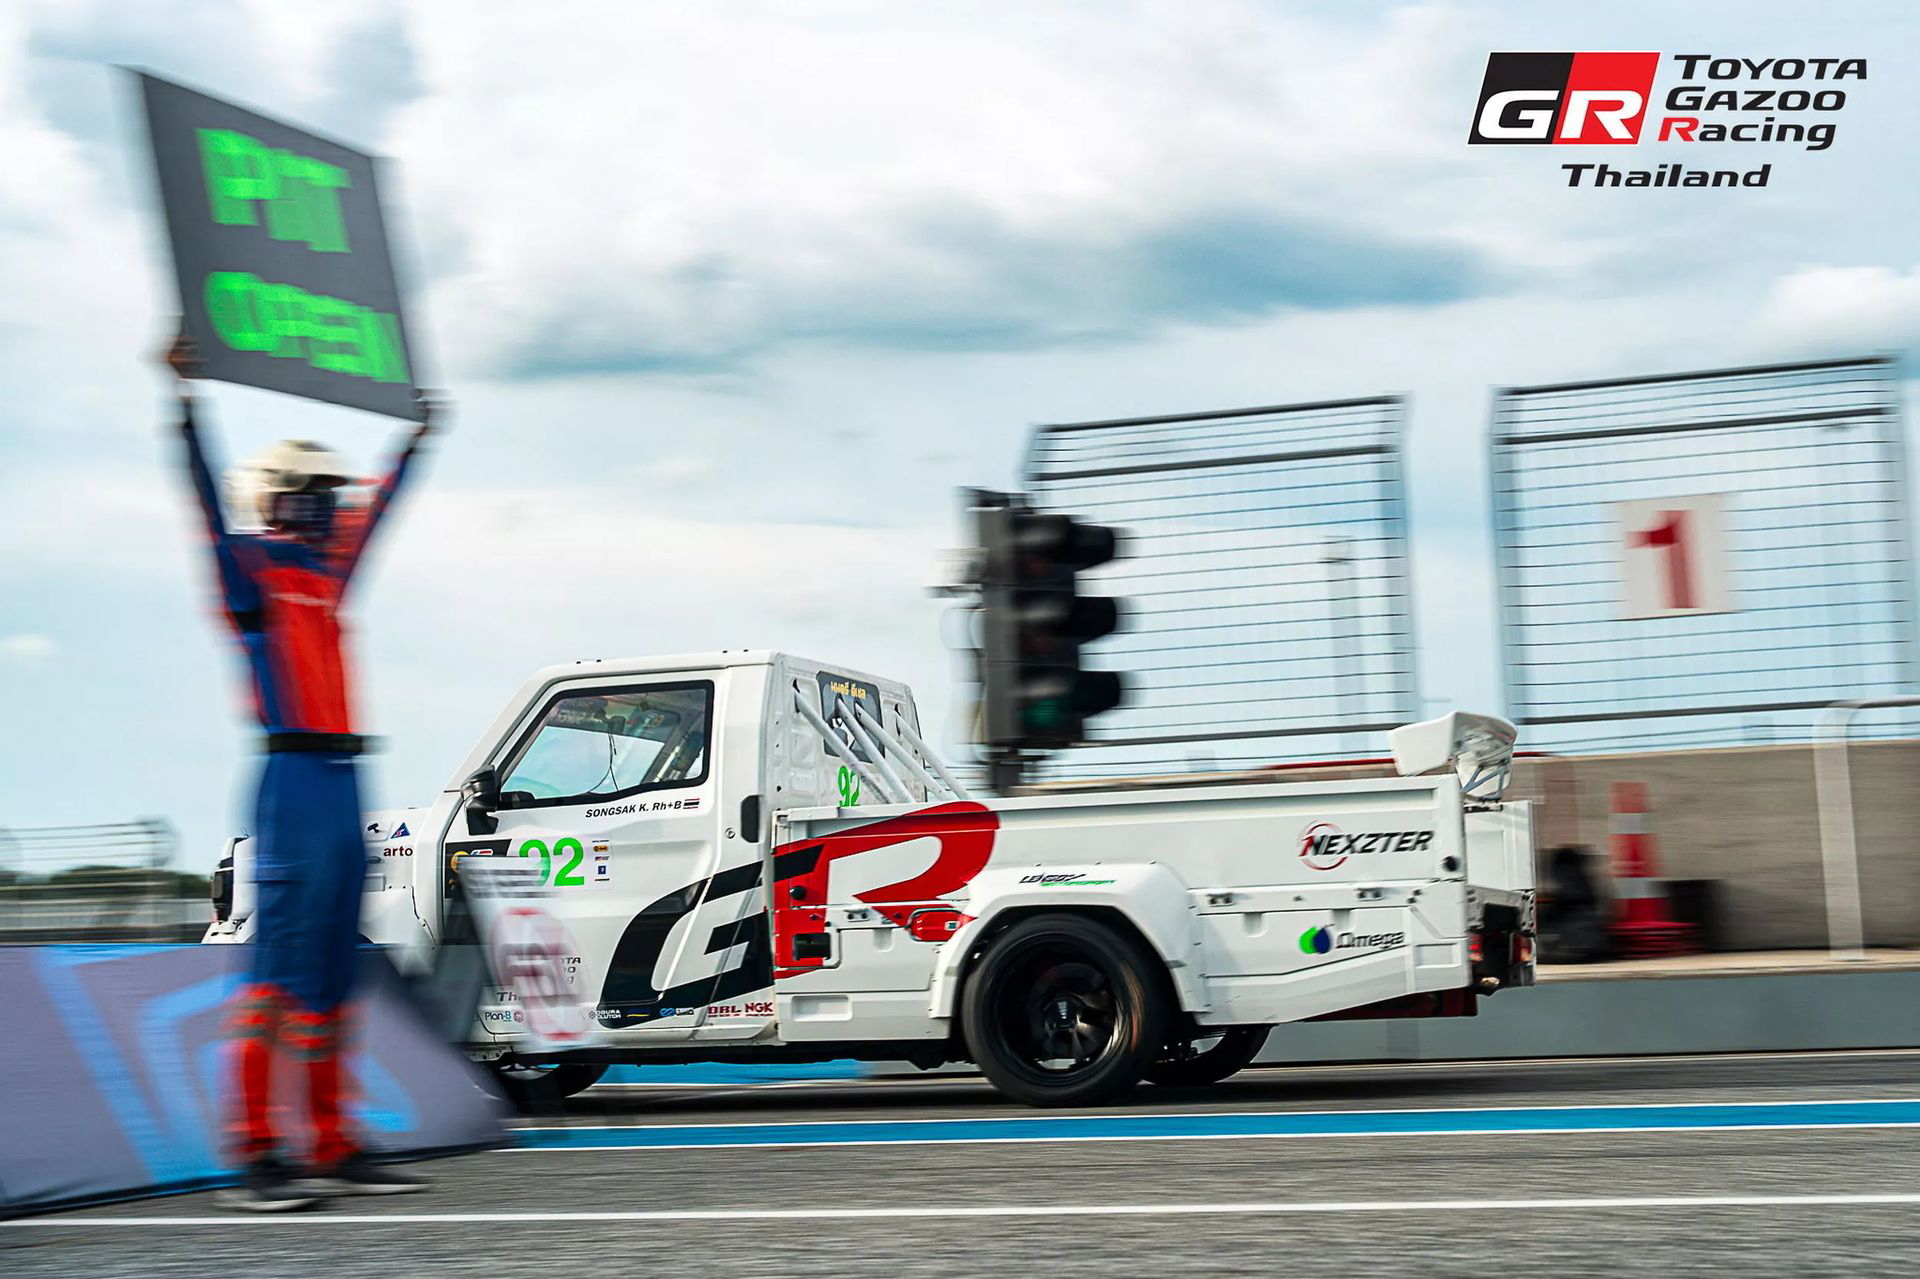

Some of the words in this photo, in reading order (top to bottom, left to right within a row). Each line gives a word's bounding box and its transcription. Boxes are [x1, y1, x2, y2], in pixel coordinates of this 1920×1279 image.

[194, 127, 353, 253] PIT
[203, 271, 411, 384] OPEN
[1627, 509, 1702, 610] 1
[837, 765, 861, 807] 92
[585, 804, 636, 818] SONGSAK
[638, 803, 649, 812] K.
[383, 845, 414, 857] arto
[1298, 830, 1434, 857] NEXZTER
[1335, 931, 1405, 949] Omega
[745, 1002, 773, 1013] NGK
